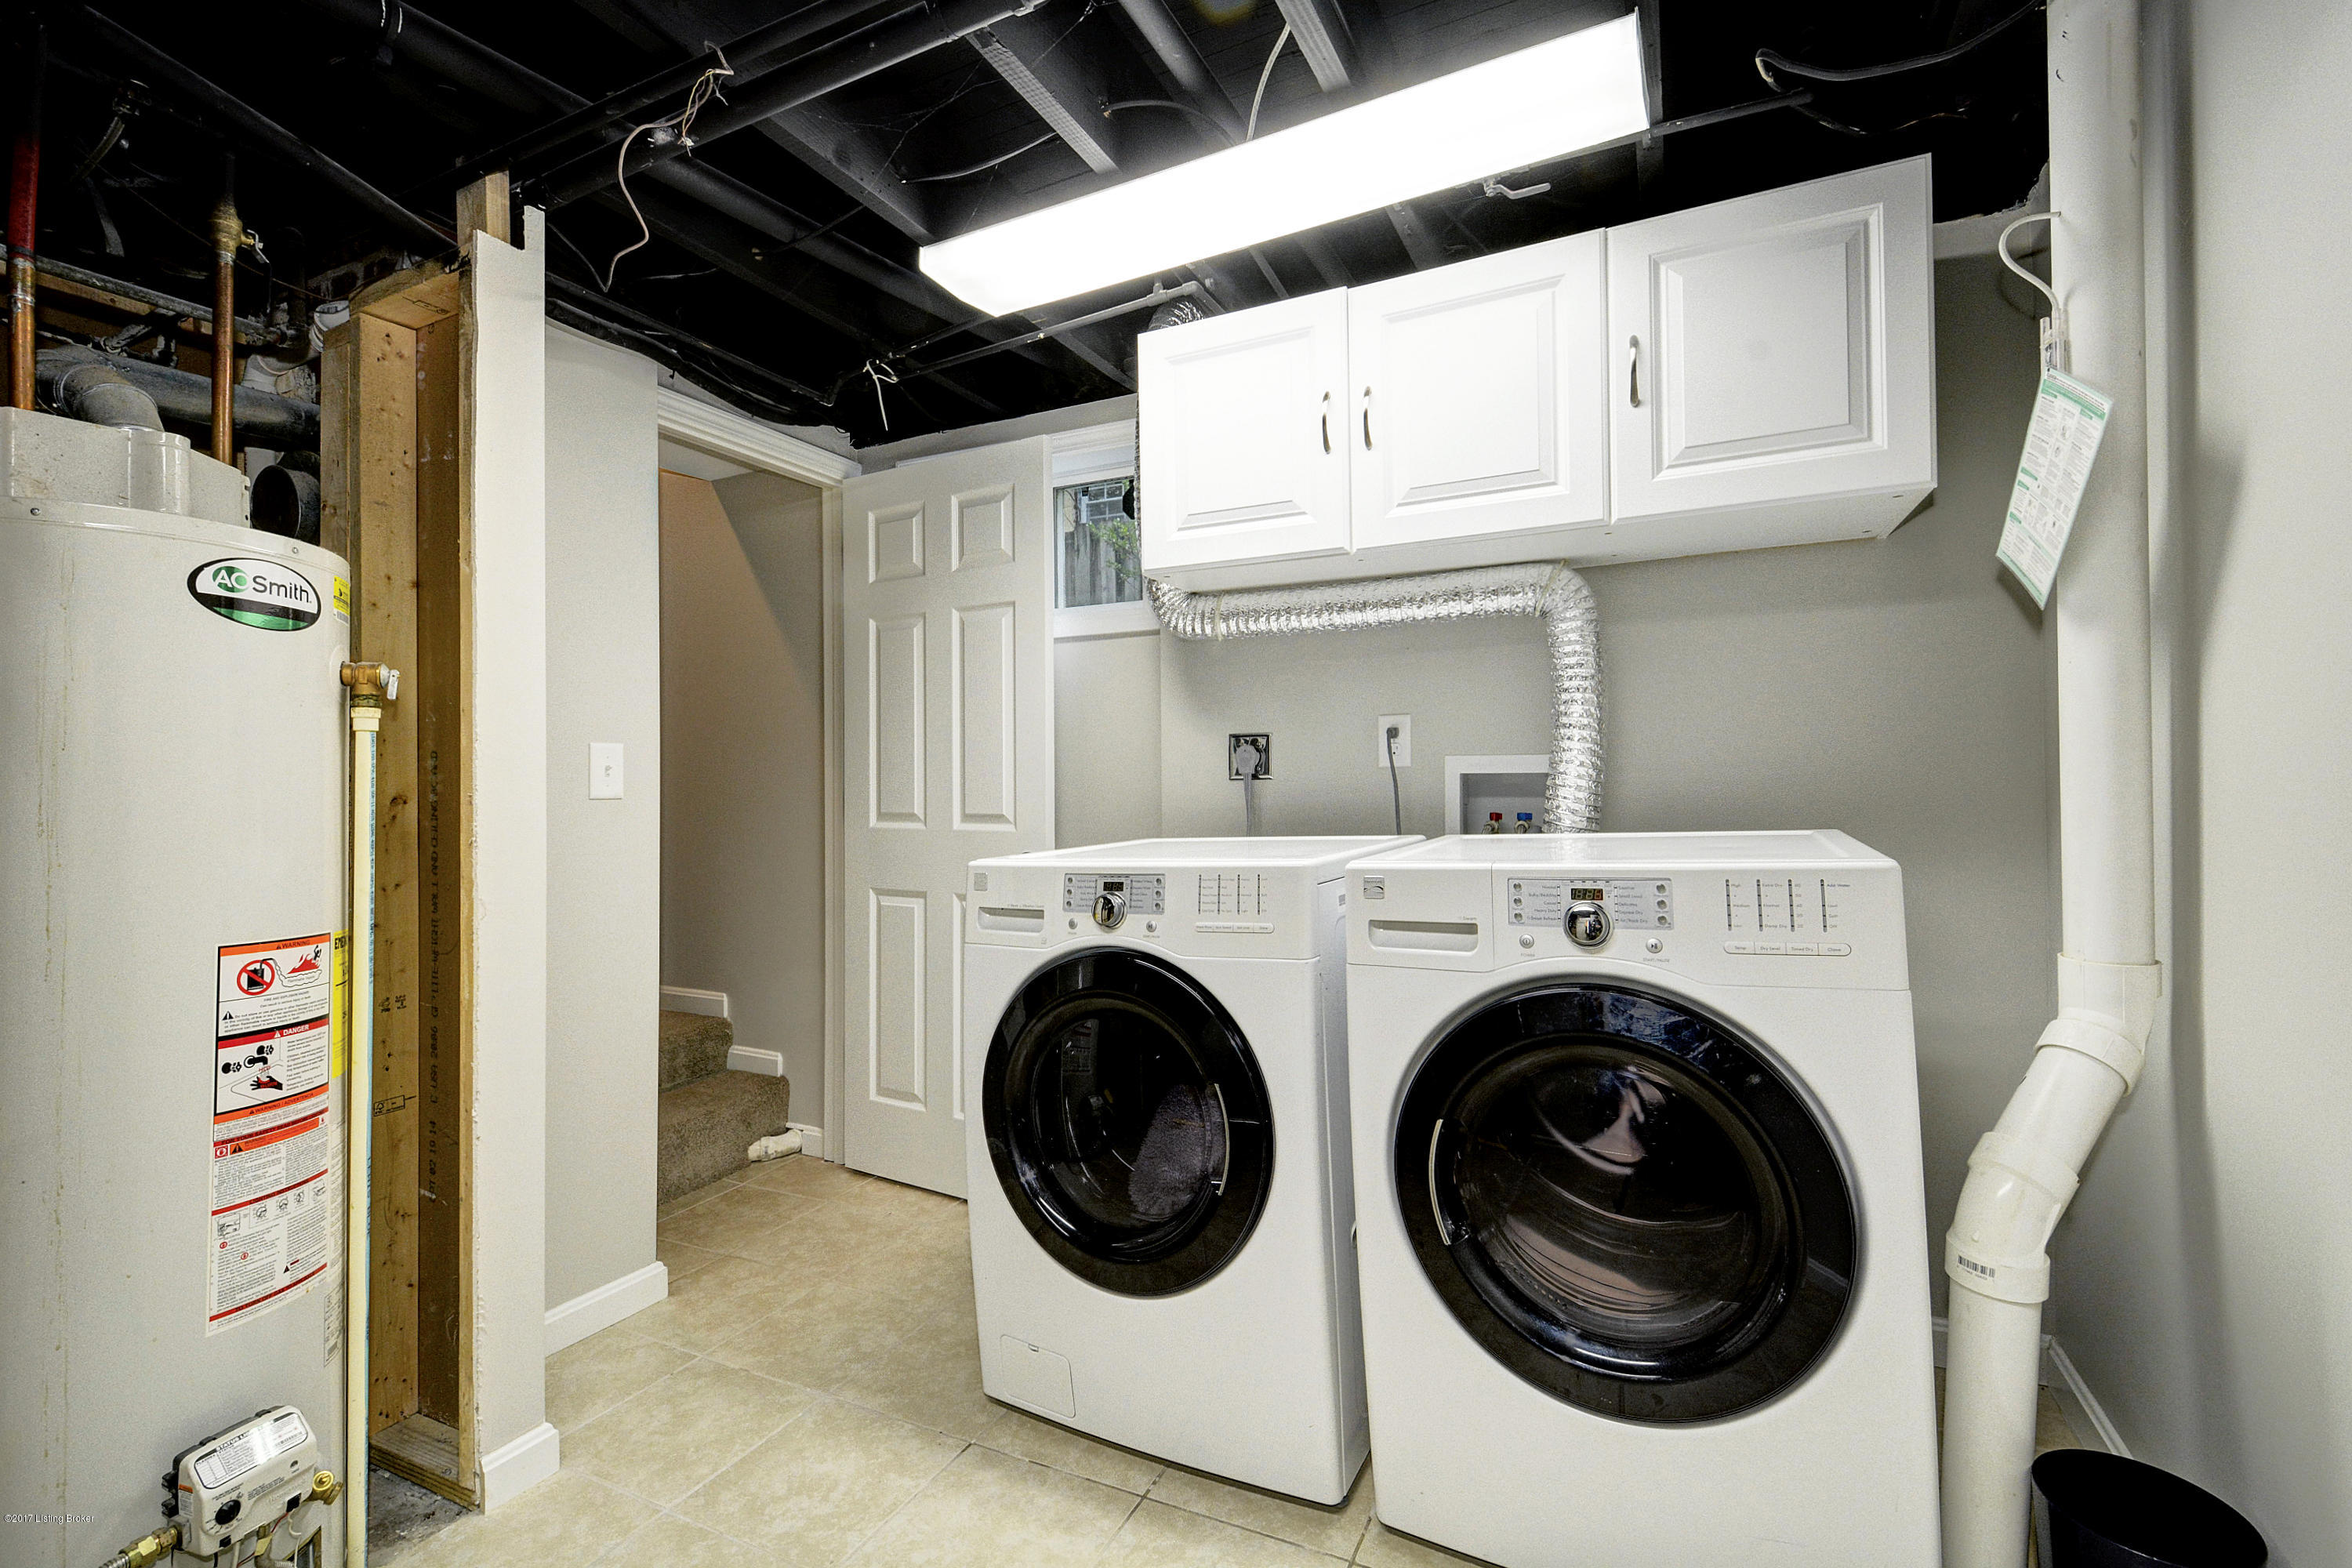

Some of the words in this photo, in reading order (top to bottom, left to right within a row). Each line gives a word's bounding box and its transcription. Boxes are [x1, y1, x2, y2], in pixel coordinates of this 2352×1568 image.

[215, 568, 249, 590] AO
[252, 575, 310, 604] Smith
[281, 940, 310, 950] WARNING
[282, 1024, 310, 1036] DANGER
[255, 1102, 281, 1113] WARNING
[221, 1136, 239, 1145] FOR
